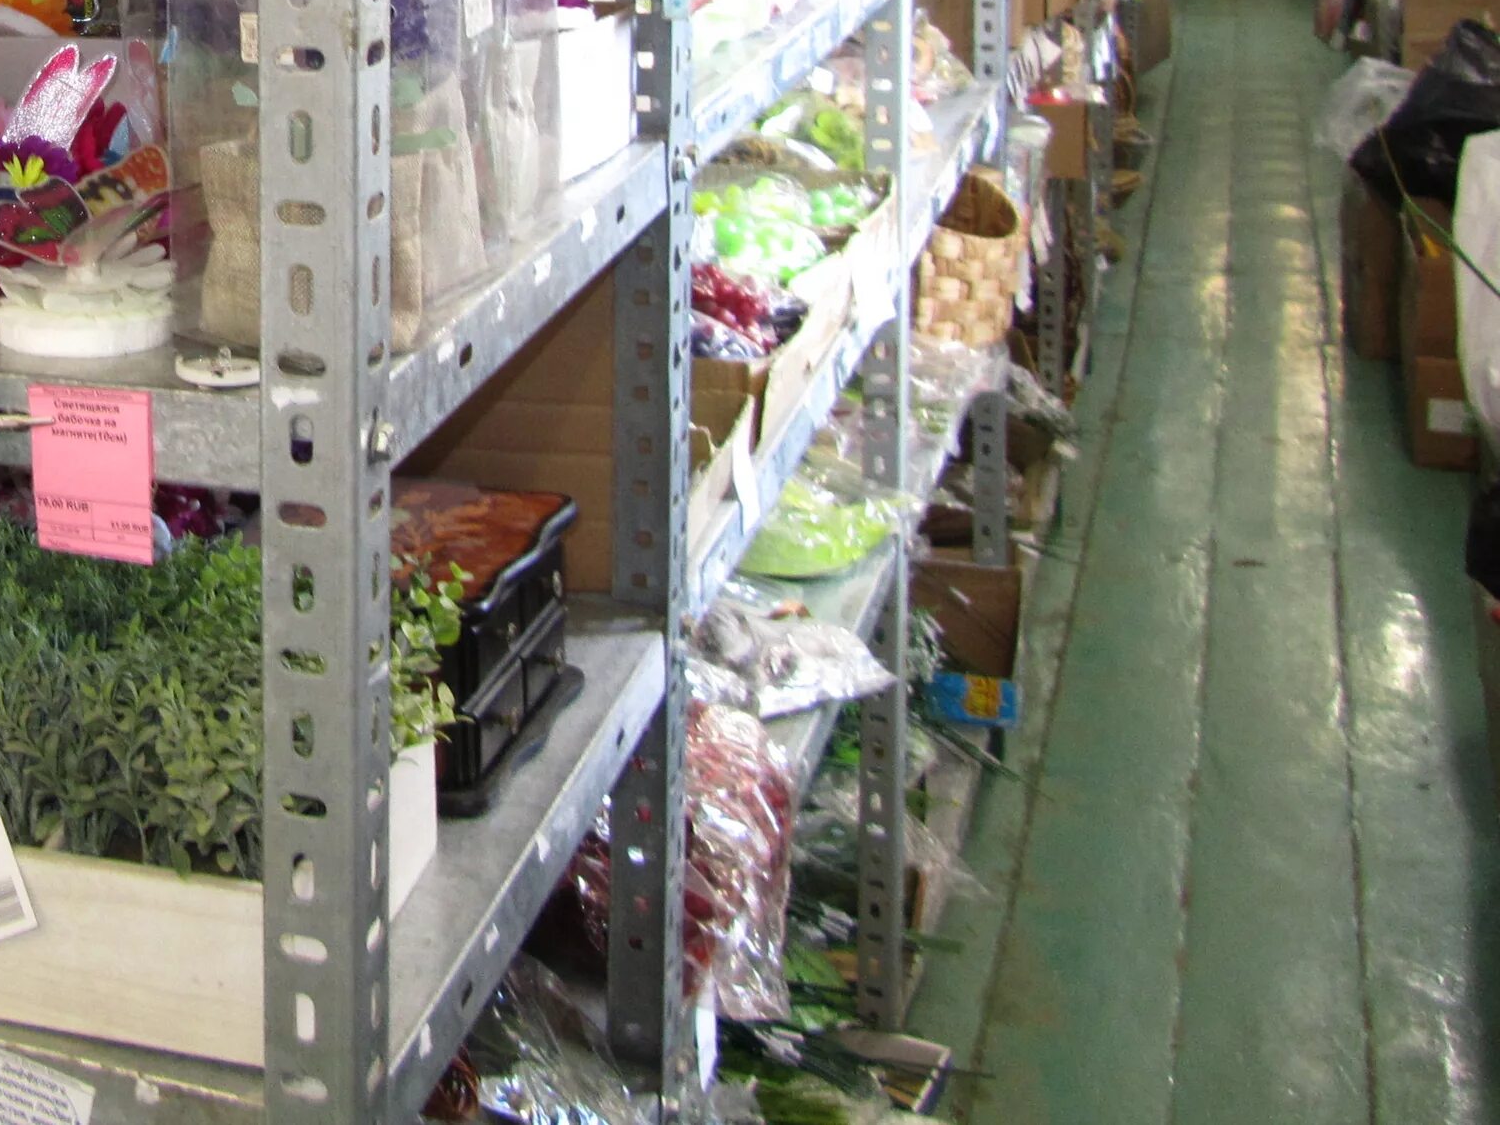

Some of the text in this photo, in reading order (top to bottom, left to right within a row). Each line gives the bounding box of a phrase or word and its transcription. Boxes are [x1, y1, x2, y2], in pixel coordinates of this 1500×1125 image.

[53, 399, 120, 415] Светящаяся
[57, 414, 117, 428] бабочка на
[66, 500, 90, 513] RUB
